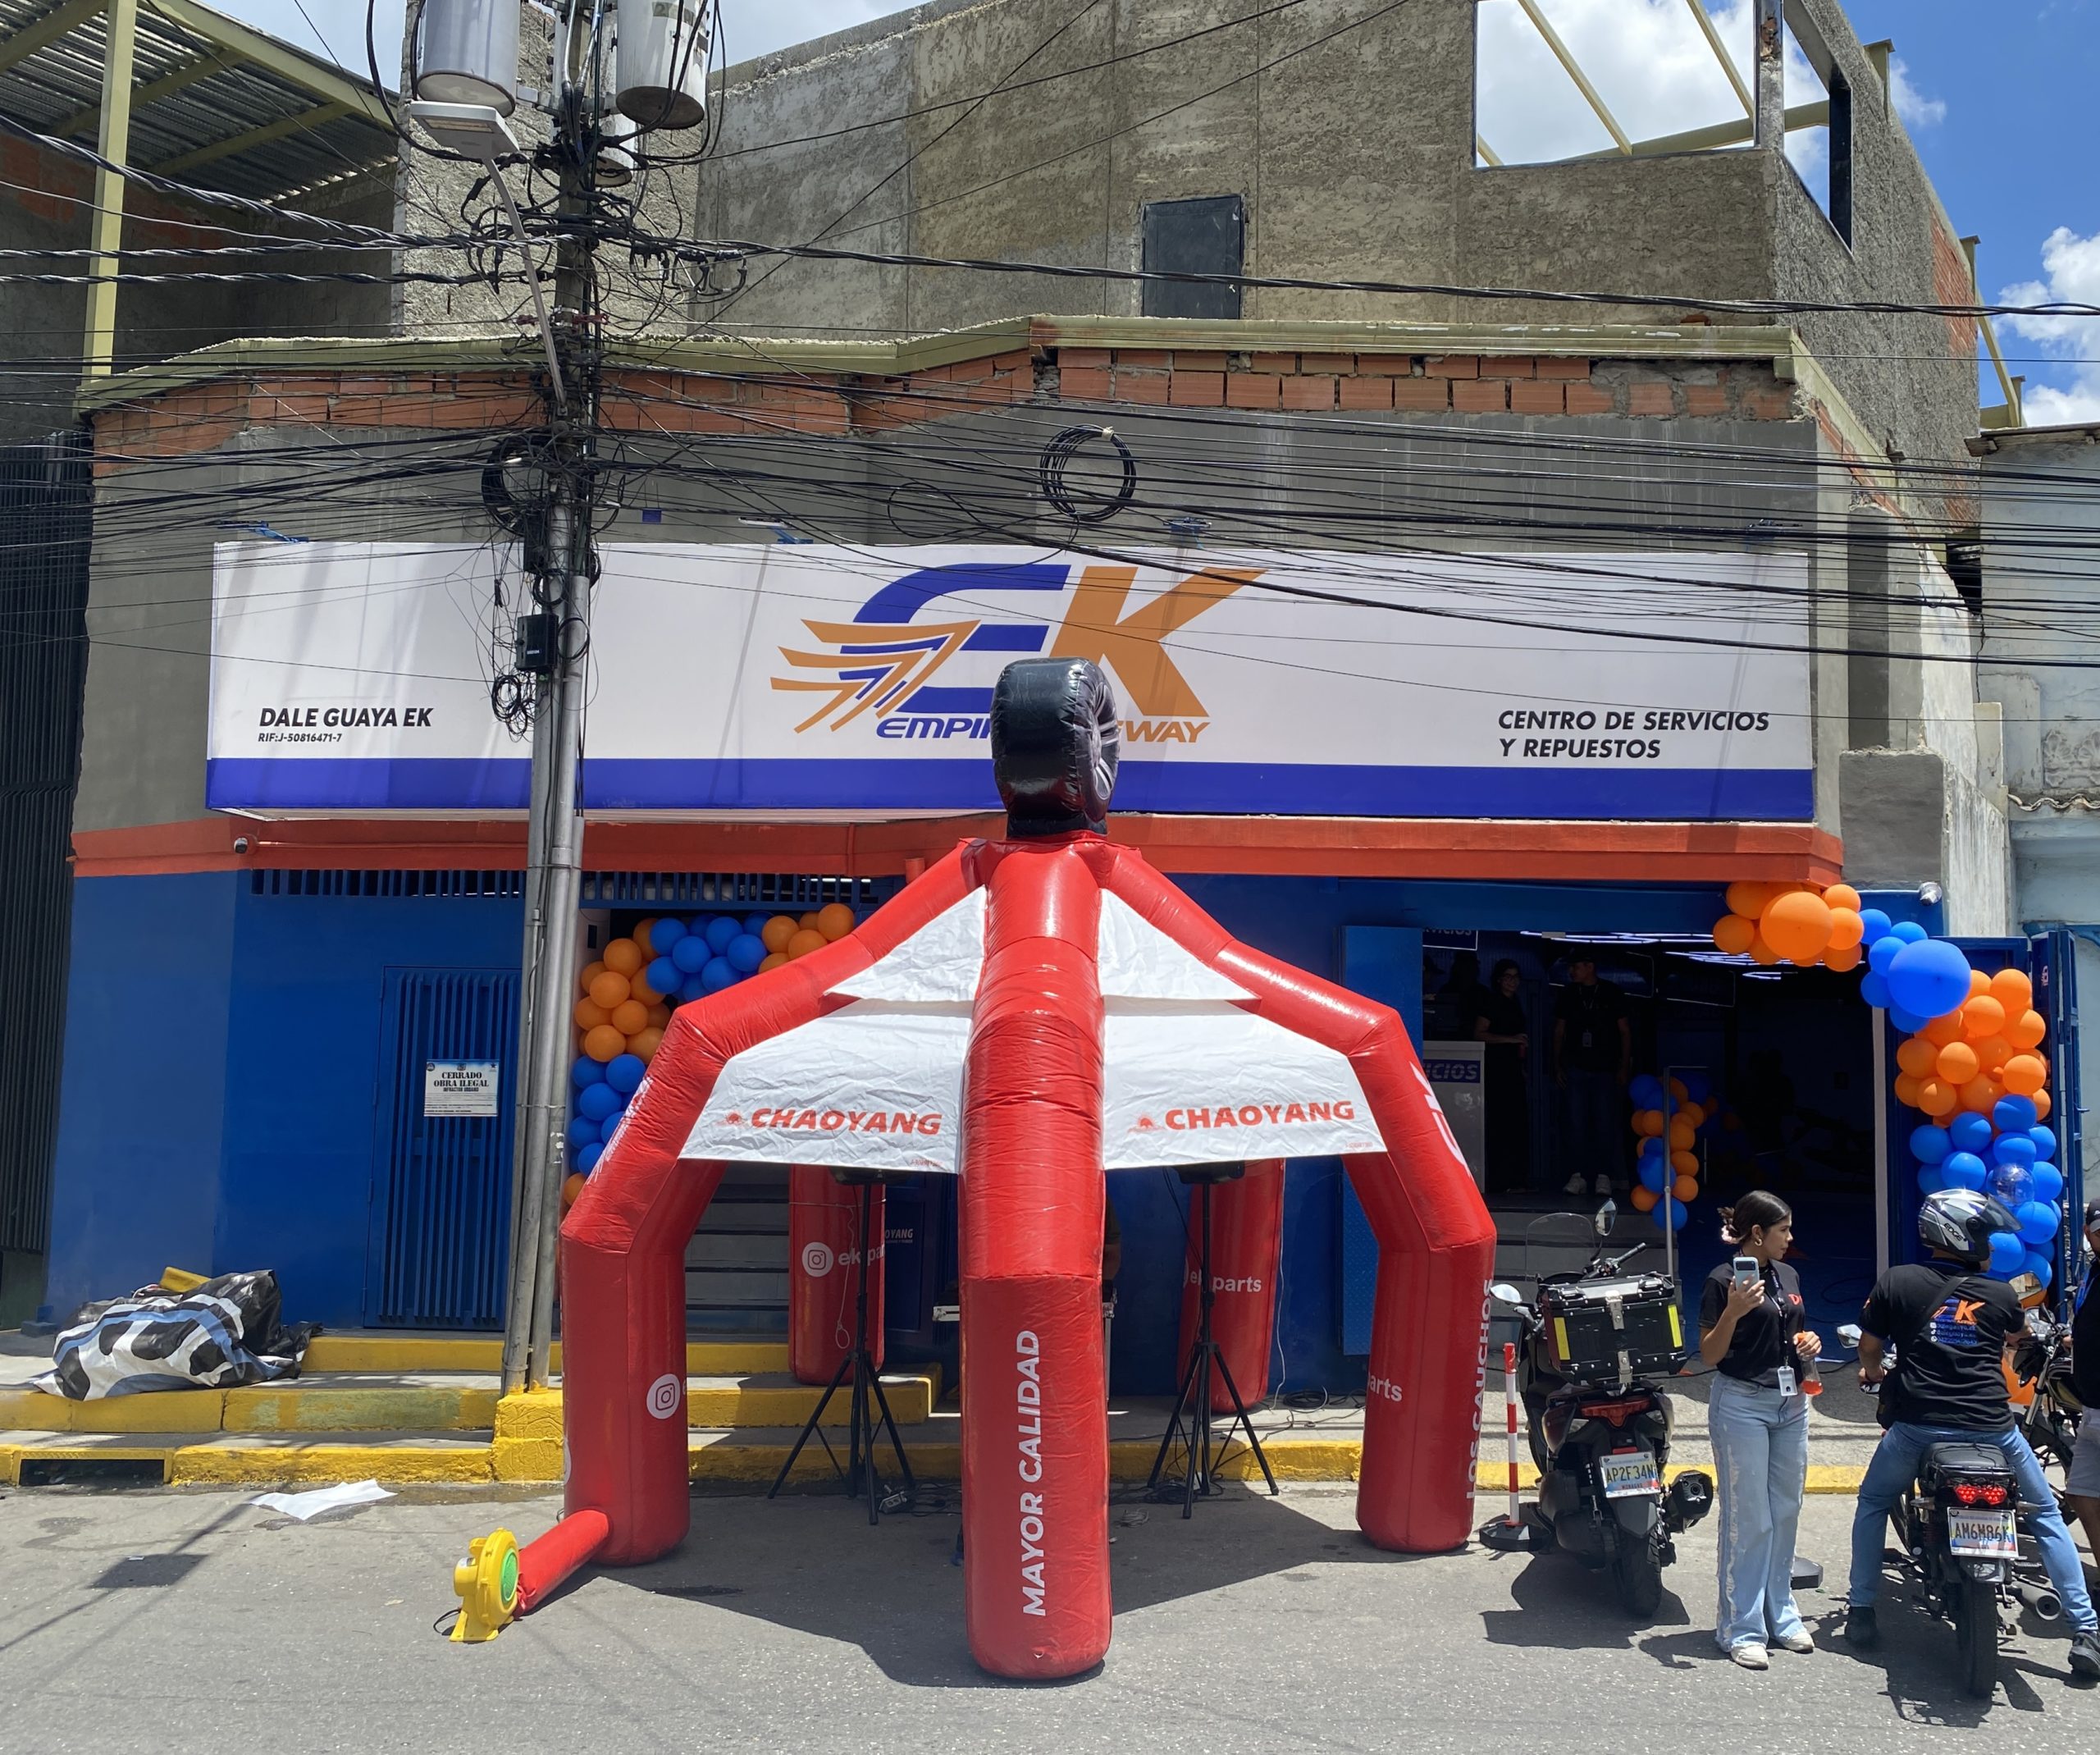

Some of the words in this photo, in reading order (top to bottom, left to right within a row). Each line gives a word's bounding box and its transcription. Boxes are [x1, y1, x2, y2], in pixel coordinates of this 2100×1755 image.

[259, 707, 319, 727] DALE
[323, 707, 398, 728] GUAYA
[403, 707, 434, 727] EK
[1498, 710, 1596, 729] CENTRO
[1605, 711, 1636, 730] DE
[1643, 711, 1769, 731] SERVICIOS
[258, 733, 342, 743] RIF:J-50816471-7
[1500, 738, 1516, 756] Y
[1523, 739, 1661, 758] REPUESTOS
[751, 1108, 943, 1136] CHAOYANG
[1165, 1100, 1354, 1131] CHAOYANG
[1943, 1223, 1963, 1241] EDGE
[1212, 1276, 1262, 1293] parts
[1368, 1373, 1403, 1401] arts
[1016, 1330, 1043, 1483] CALIDAD
[1606, 1464, 1655, 1483] AP2F34N
[1020, 1493, 1046, 1616] MAYOR
